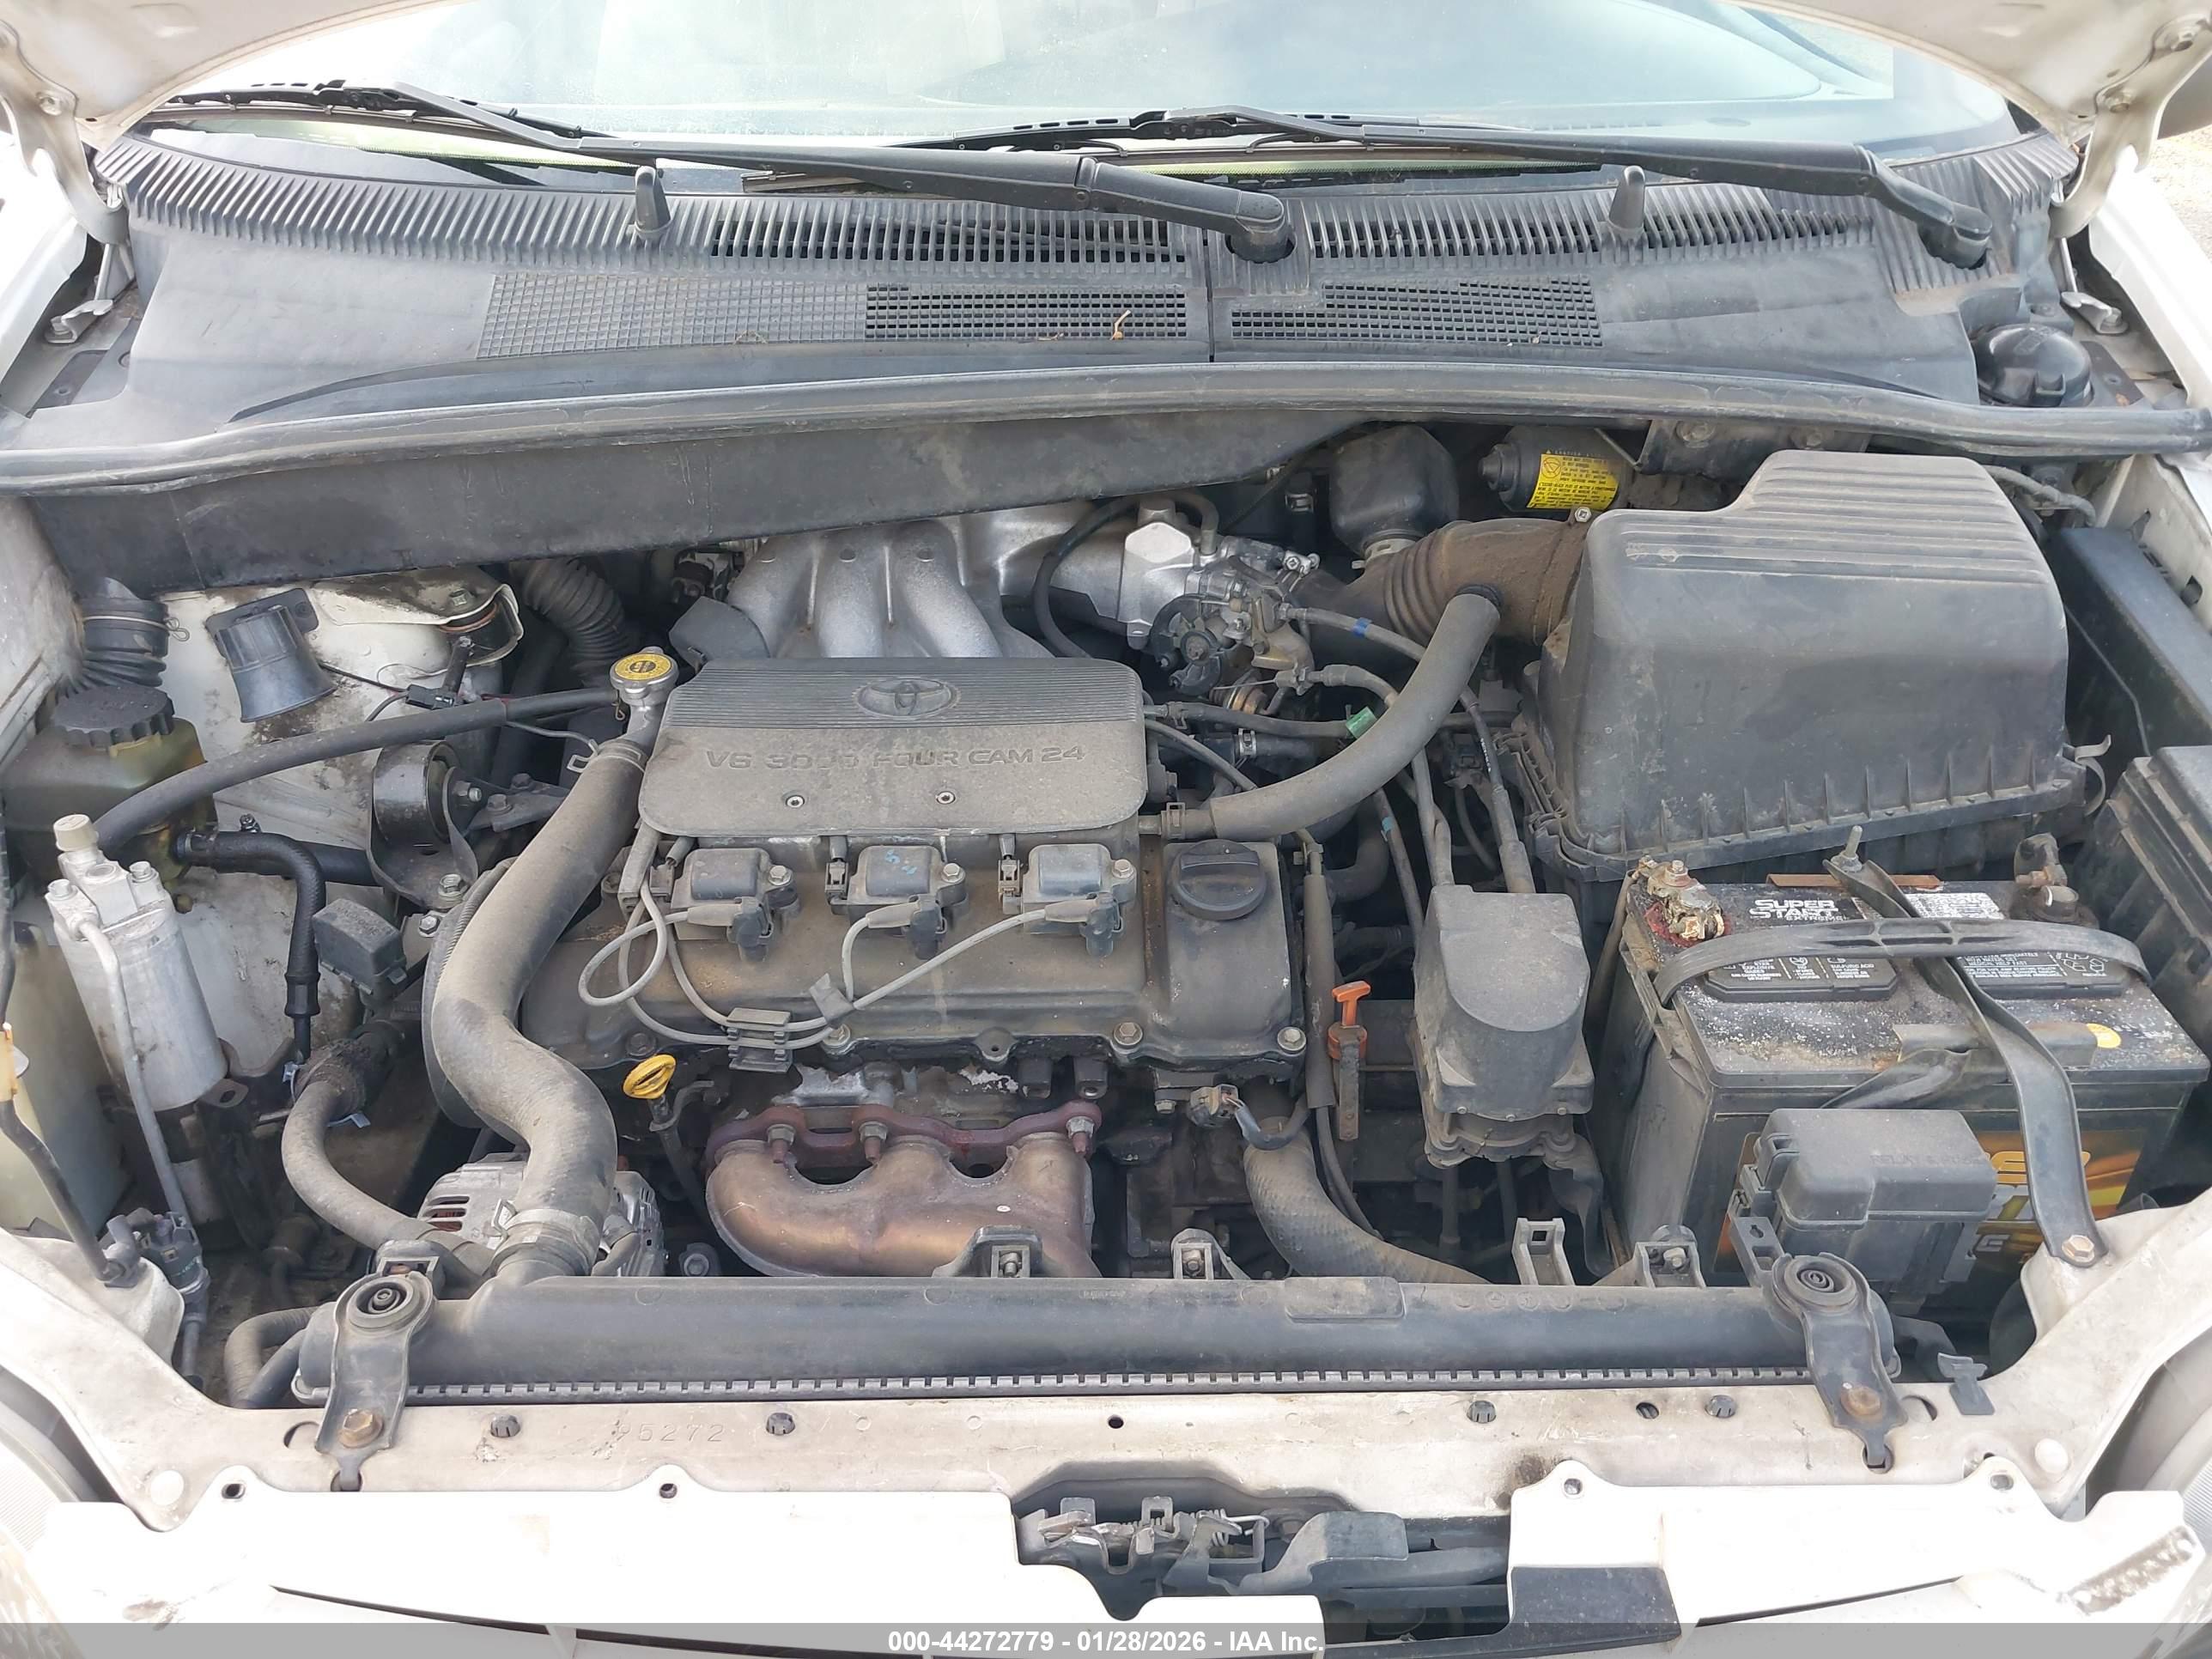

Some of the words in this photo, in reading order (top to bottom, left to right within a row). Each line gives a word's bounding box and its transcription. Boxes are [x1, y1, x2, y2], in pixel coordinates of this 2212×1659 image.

[706, 750, 752, 769] V6
[872, 748, 960, 769] FOUR
[968, 747, 1033, 764] CAM
[1041, 744, 1086, 763] 24
[1754, 899, 1836, 909] SUPER
[1748, 908, 1839, 920] START
